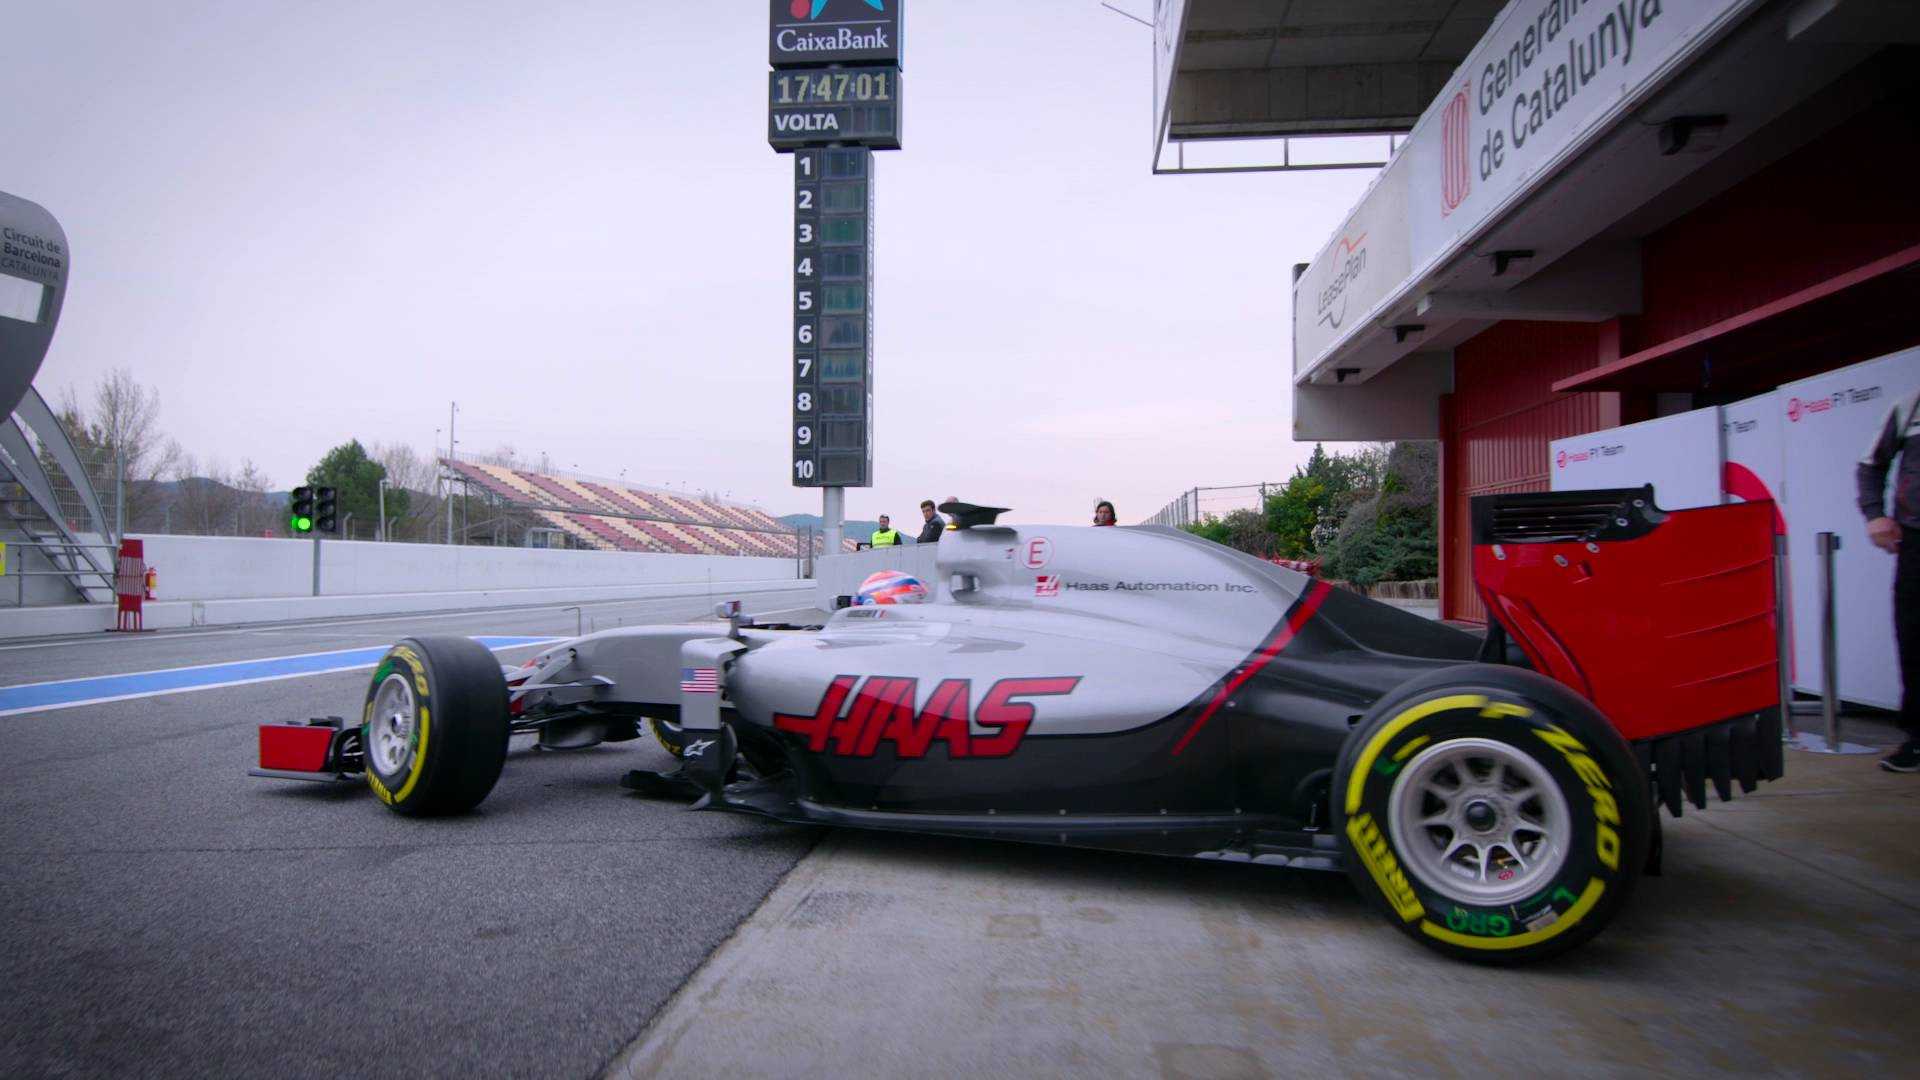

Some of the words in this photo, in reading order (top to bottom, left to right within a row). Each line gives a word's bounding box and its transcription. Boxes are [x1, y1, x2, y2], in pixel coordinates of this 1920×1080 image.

[776, 27, 889, 52] CaixaBank
[777, 72, 889, 103] 17:47:01
[1479, 129, 1504, 182] de
[1511, 0, 1663, 149] Catalunya
[774, 113, 839, 131] VOLTA
[800, 156, 811, 175] 1
[798, 190, 813, 209] 2
[3, 227, 44, 250] Circuit
[46, 240, 61, 254] de
[798, 224, 813, 242] 3
[4, 242, 61, 268] Barcelona
[797, 257, 813, 276] 4
[798, 291, 813, 310] 5
[798, 324, 813, 343] 6
[798, 358, 812, 377] 7
[797, 392, 812, 411] 8
[797, 426, 812, 445] 9
[795, 460, 814, 478] 10
[1028, 541, 1045, 565] E
[1065, 581, 1110, 592] Haas
[1116, 581, 1220, 593] Automation
[1225, 582, 1258, 594] Inc.
[773, 674, 1084, 759] HAAS
